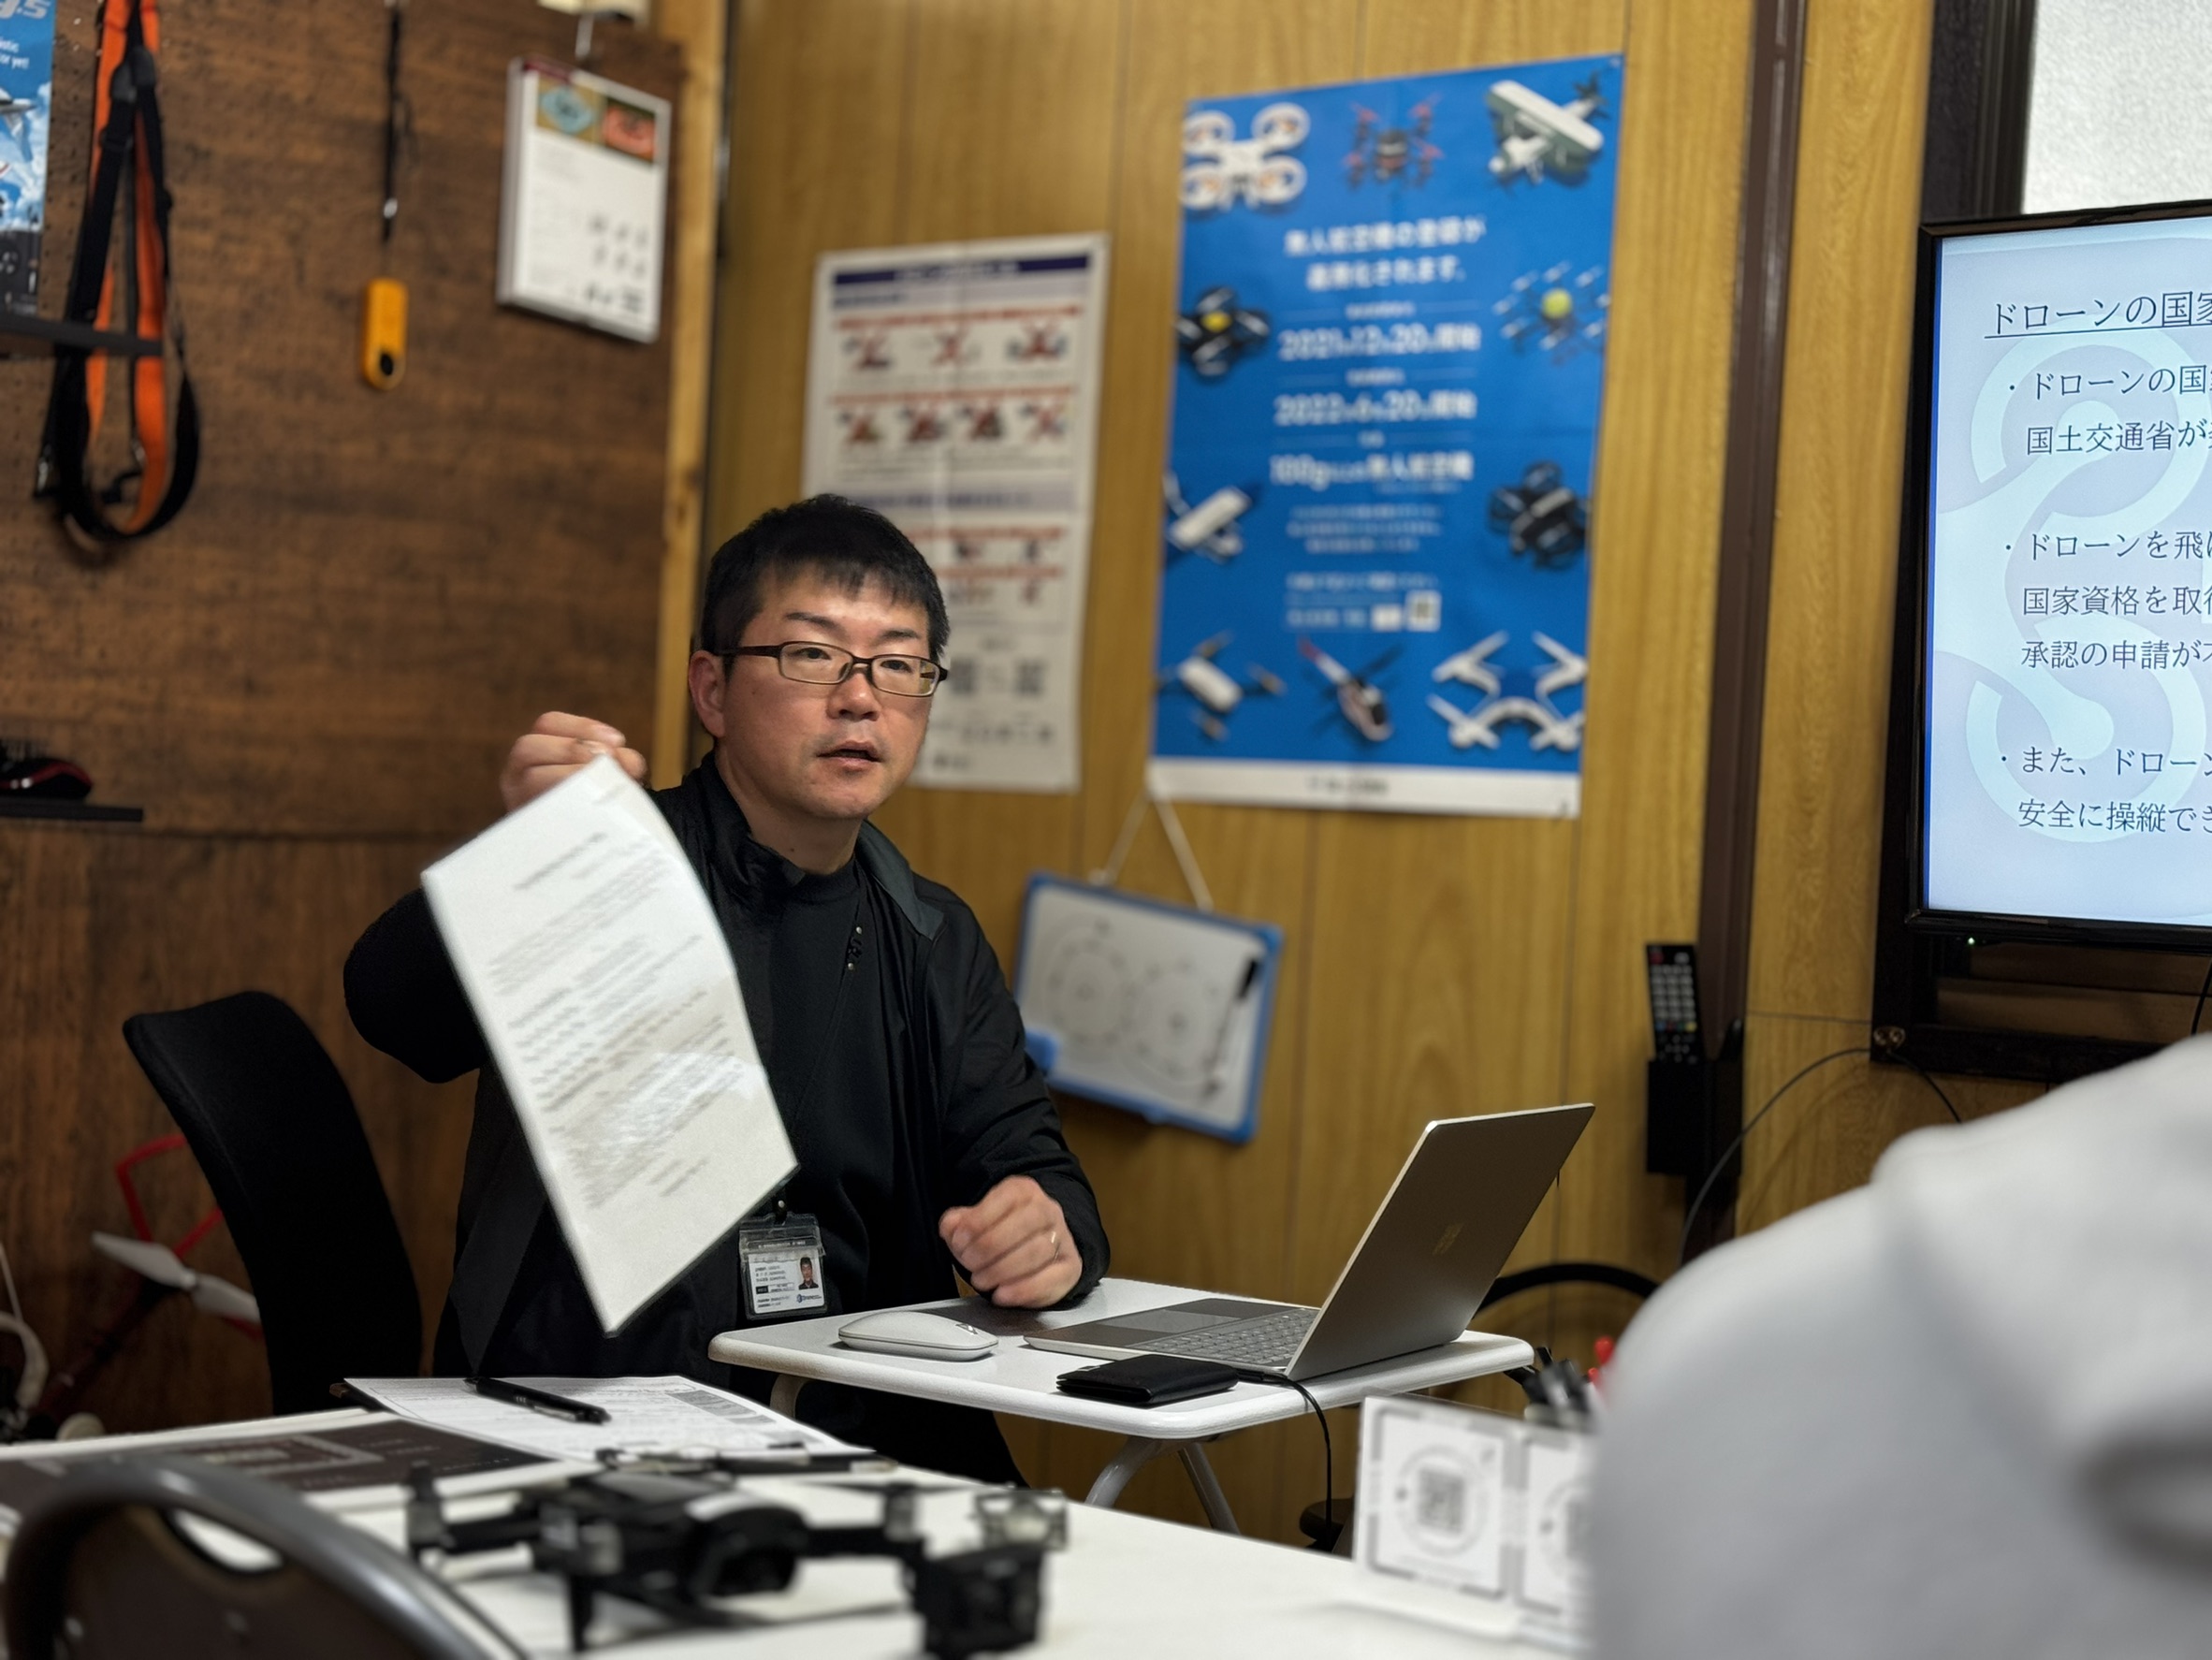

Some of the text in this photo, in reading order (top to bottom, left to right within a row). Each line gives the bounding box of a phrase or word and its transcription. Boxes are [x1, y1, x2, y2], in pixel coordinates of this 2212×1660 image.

[2027, 418, 2212, 455] 国土交通省が
